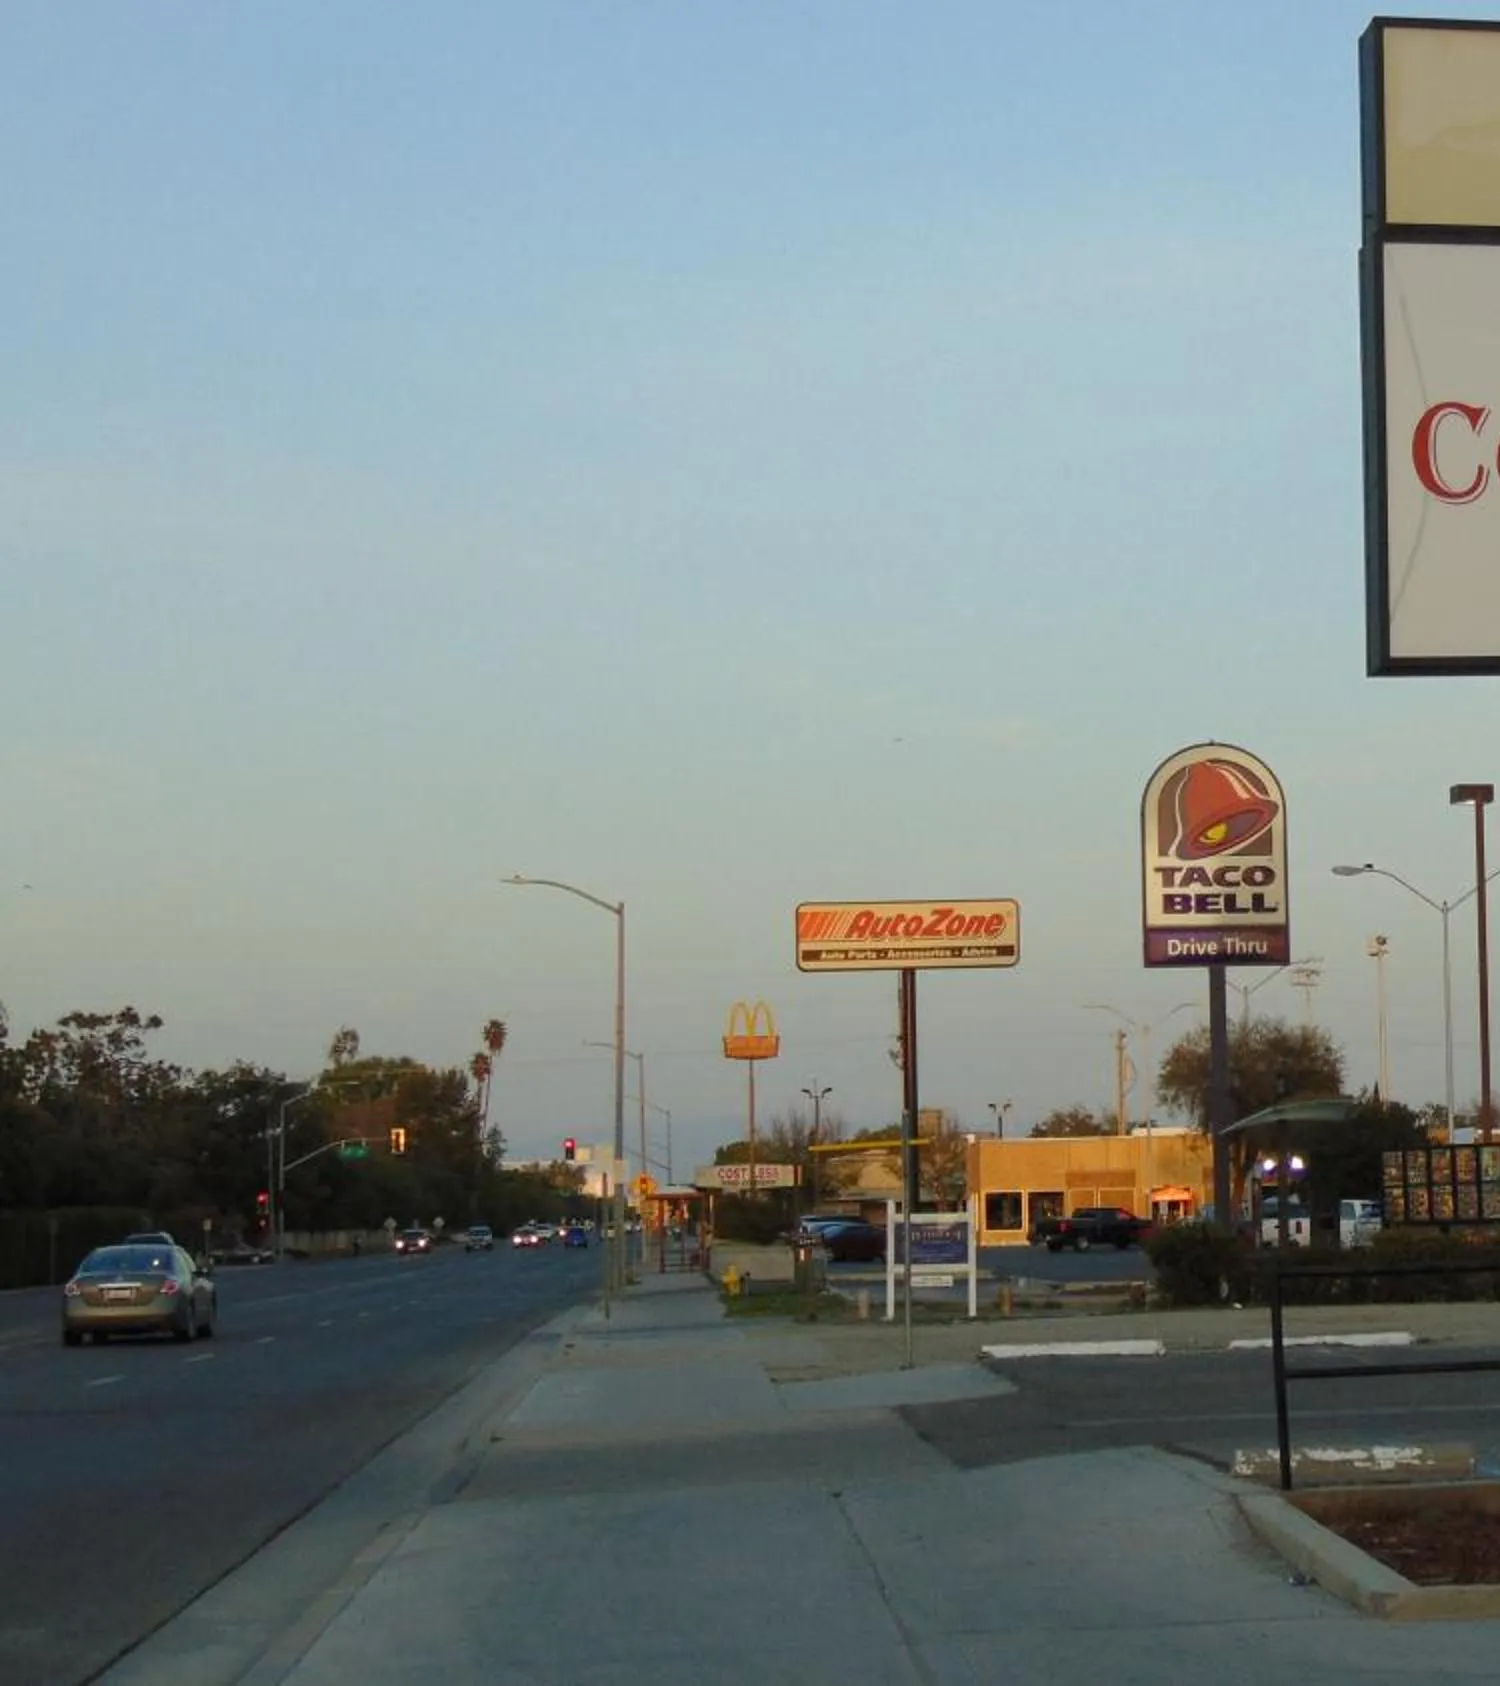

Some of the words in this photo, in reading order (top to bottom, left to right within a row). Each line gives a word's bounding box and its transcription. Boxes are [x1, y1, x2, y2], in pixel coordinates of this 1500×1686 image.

[1153, 865, 1276, 888] TACO
[1162, 893, 1278, 914] BELL
[844, 907, 1006, 939] AutoZone
[1166, 938, 1218, 956] Drive
[1223, 936, 1268, 955] Thru
